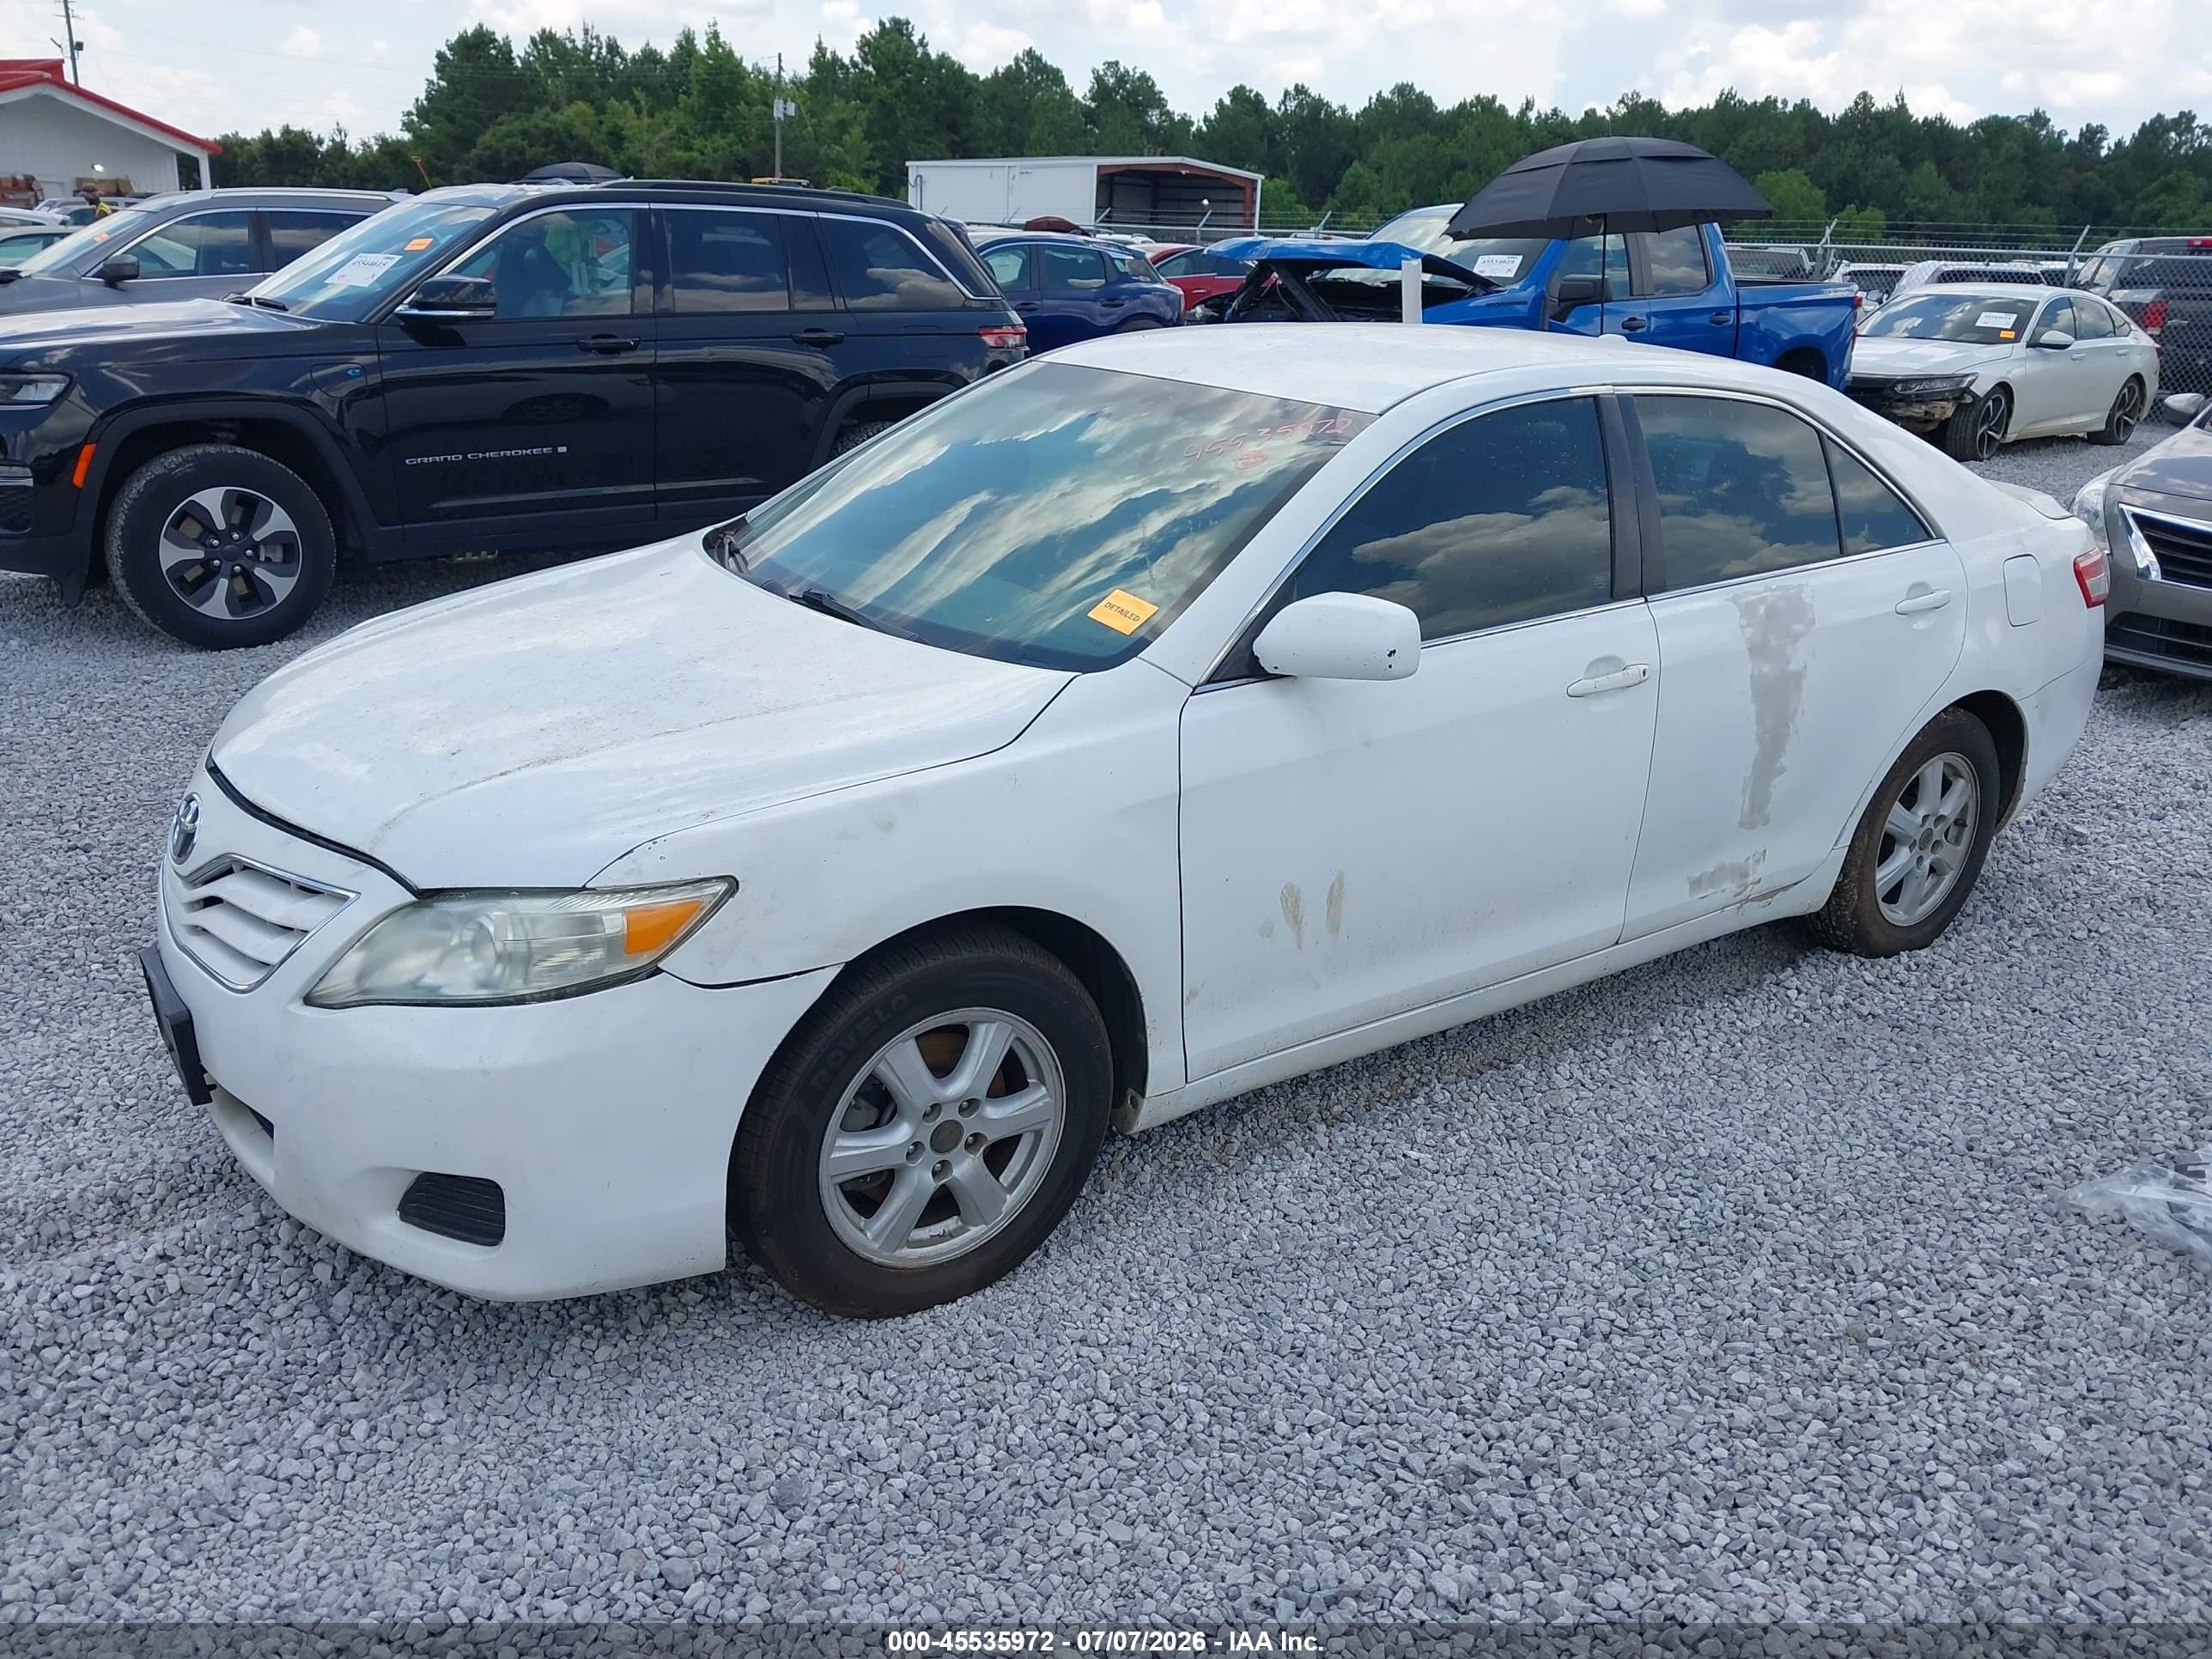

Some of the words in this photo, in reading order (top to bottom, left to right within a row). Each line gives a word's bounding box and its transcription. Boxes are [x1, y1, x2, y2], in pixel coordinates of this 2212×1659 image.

[404, 454, 463, 465] GRAND
[467, 447, 553, 459] CHEROKEE
[1103, 601, 1141, 623] DETAILED
[810, 994, 909, 1092] ROVELO
